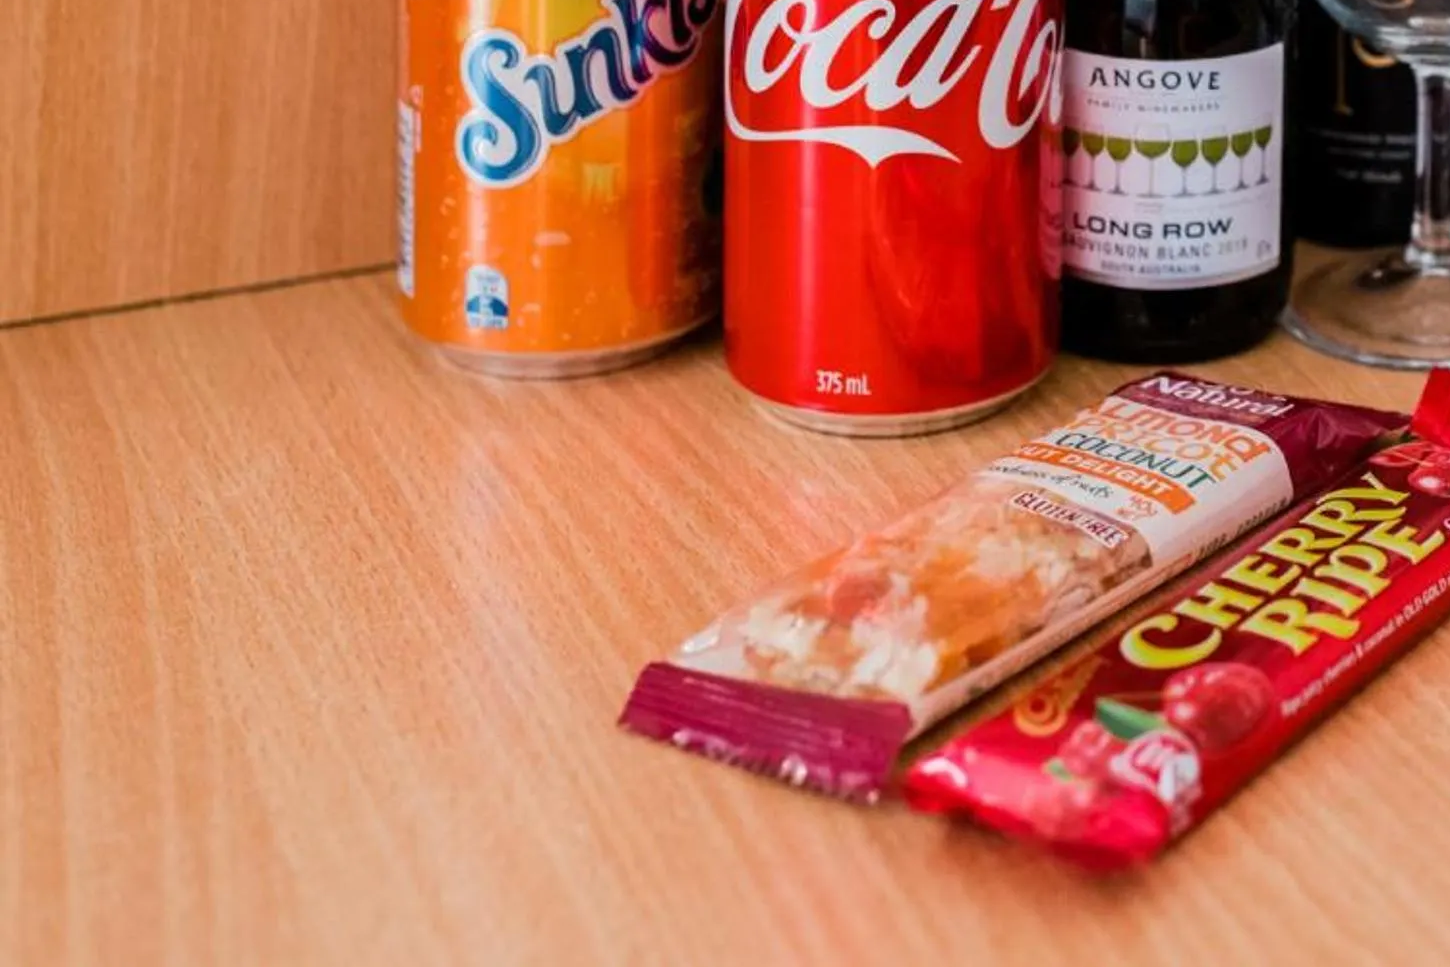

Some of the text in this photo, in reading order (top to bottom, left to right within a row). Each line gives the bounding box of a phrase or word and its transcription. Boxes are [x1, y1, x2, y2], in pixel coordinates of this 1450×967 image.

[1089, 67, 1221, 91] ANGOVE
[1073, 212, 1234, 240] LONG ROW
[1156, 241, 1212, 260] BLANC
[816, 369, 872, 396] 375 mL
[1140, 376, 1295, 417] Natural
[1055, 433, 1217, 486] COCONUT
[1060, 451, 1175, 495] DELIGHT
[1013, 492, 1122, 545] GLUTEN FREE
[1118, 472, 1413, 670] CHERRY
[1240, 505, 1446, 657] RIPE
